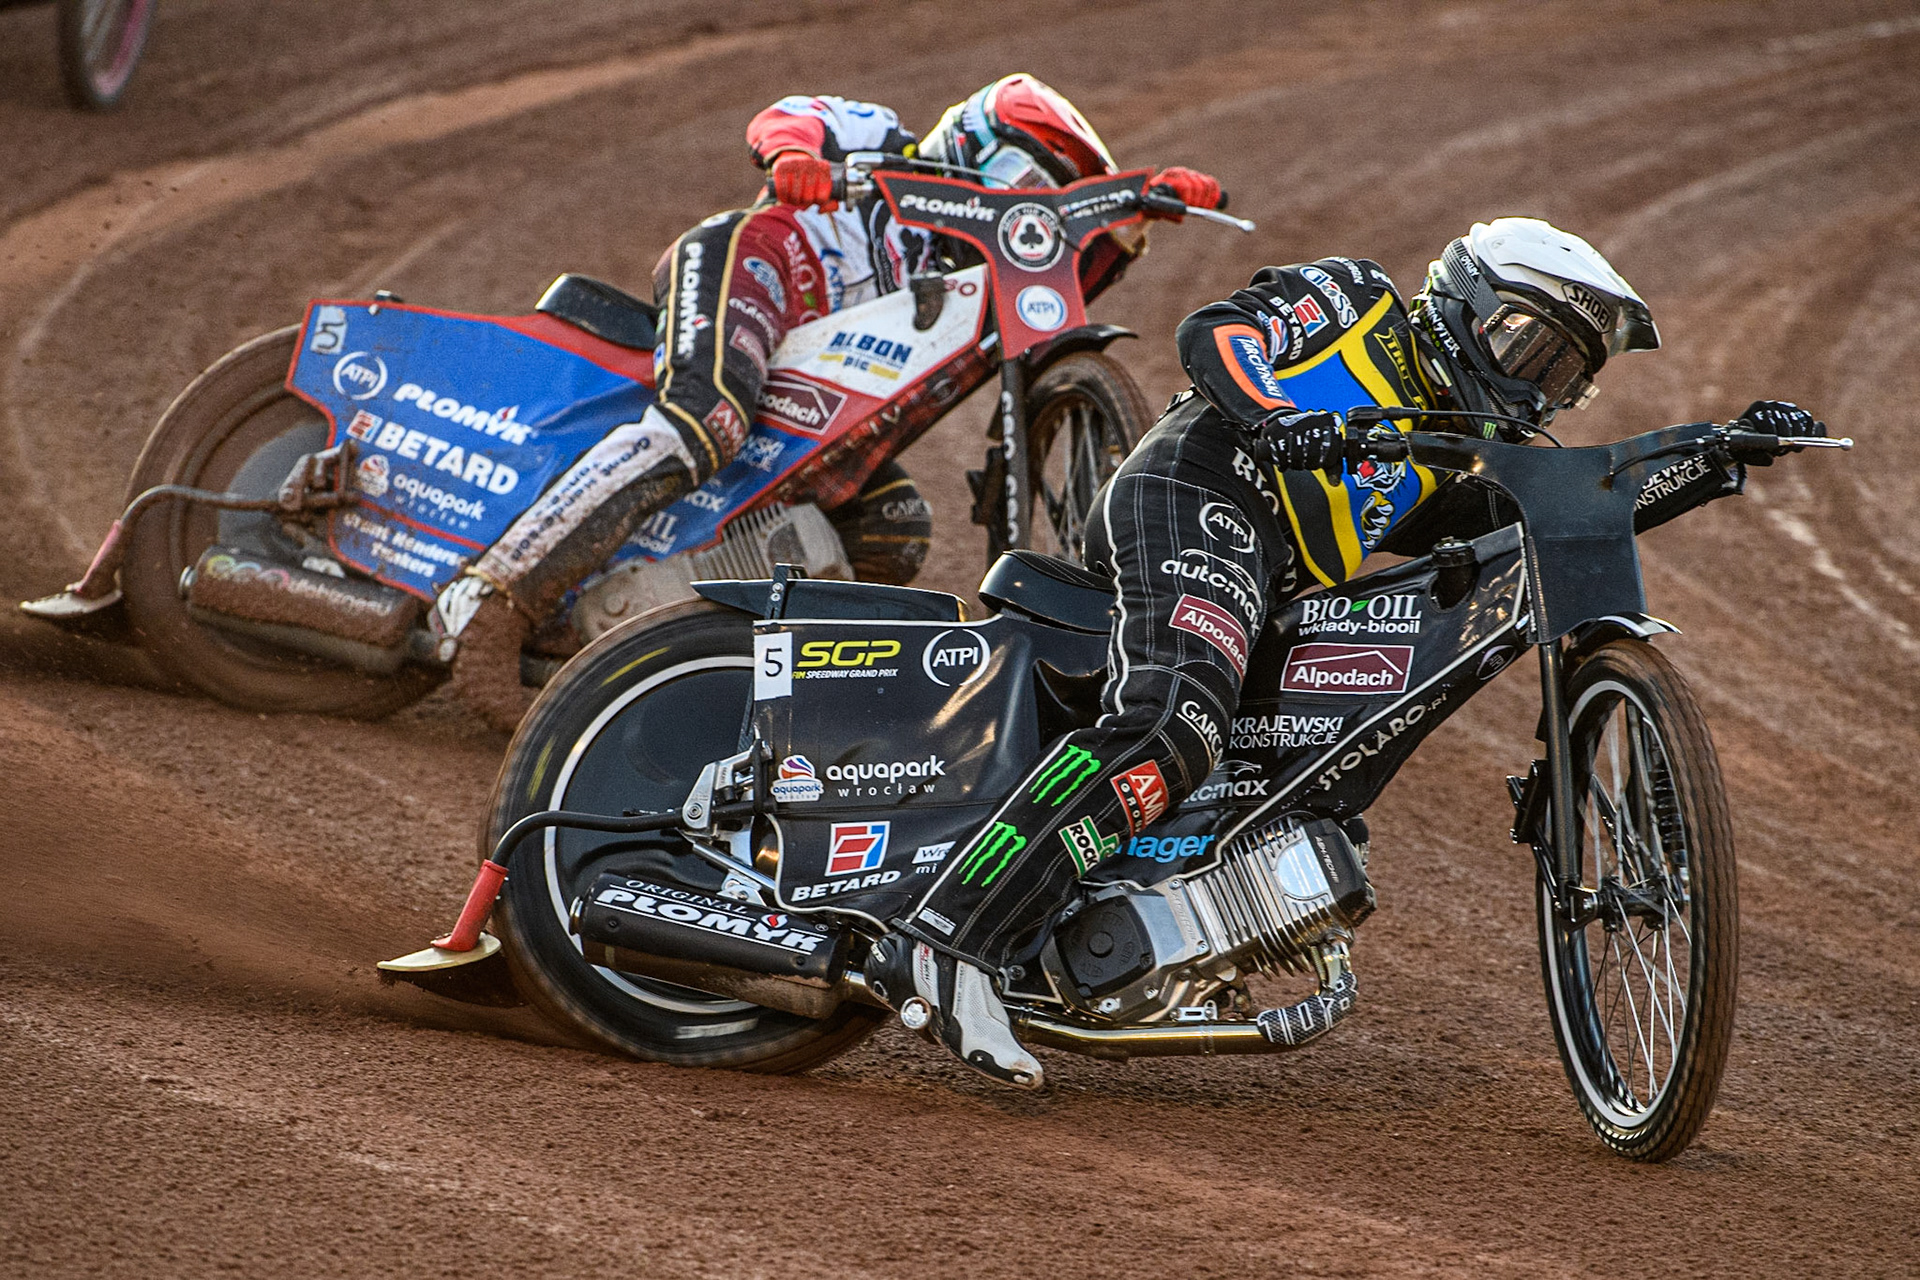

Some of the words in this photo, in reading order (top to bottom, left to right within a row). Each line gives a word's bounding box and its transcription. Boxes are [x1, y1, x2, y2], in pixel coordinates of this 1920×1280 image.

[314, 320, 345, 351] 5
[1269, 296, 1304, 360] BETARD
[340, 362, 380, 388] ATPI
[375, 421, 519, 496] BETARD
[393, 473, 486, 521] aquapark
[1633, 459, 1711, 512] NSTRUKCJE
[1208, 511, 1249, 543] ATPI
[1299, 596, 1352, 625] BIO
[1366, 594, 1422, 621] OIL
[764, 647, 784, 677] 5
[797, 640, 902, 667] SGP
[932, 646, 979, 668] ATPI
[805, 669, 849, 680] SPEEDWAY
[849, 669, 877, 679] GRAND
[878, 667, 899, 678] PRIX
[1291, 665, 1395, 688] Alpodach
[1228, 730, 1340, 750] KONSTRUKCJE
[1231, 714, 1344, 736] KRAJEWSKI
[826, 754, 946, 785] aquapark
[837, 783, 937, 798] wrocław
[625, 879, 750, 915] ORIGINAL
[790, 870, 902, 902] BETARD
[596, 888, 826, 952] PŁOMYK
